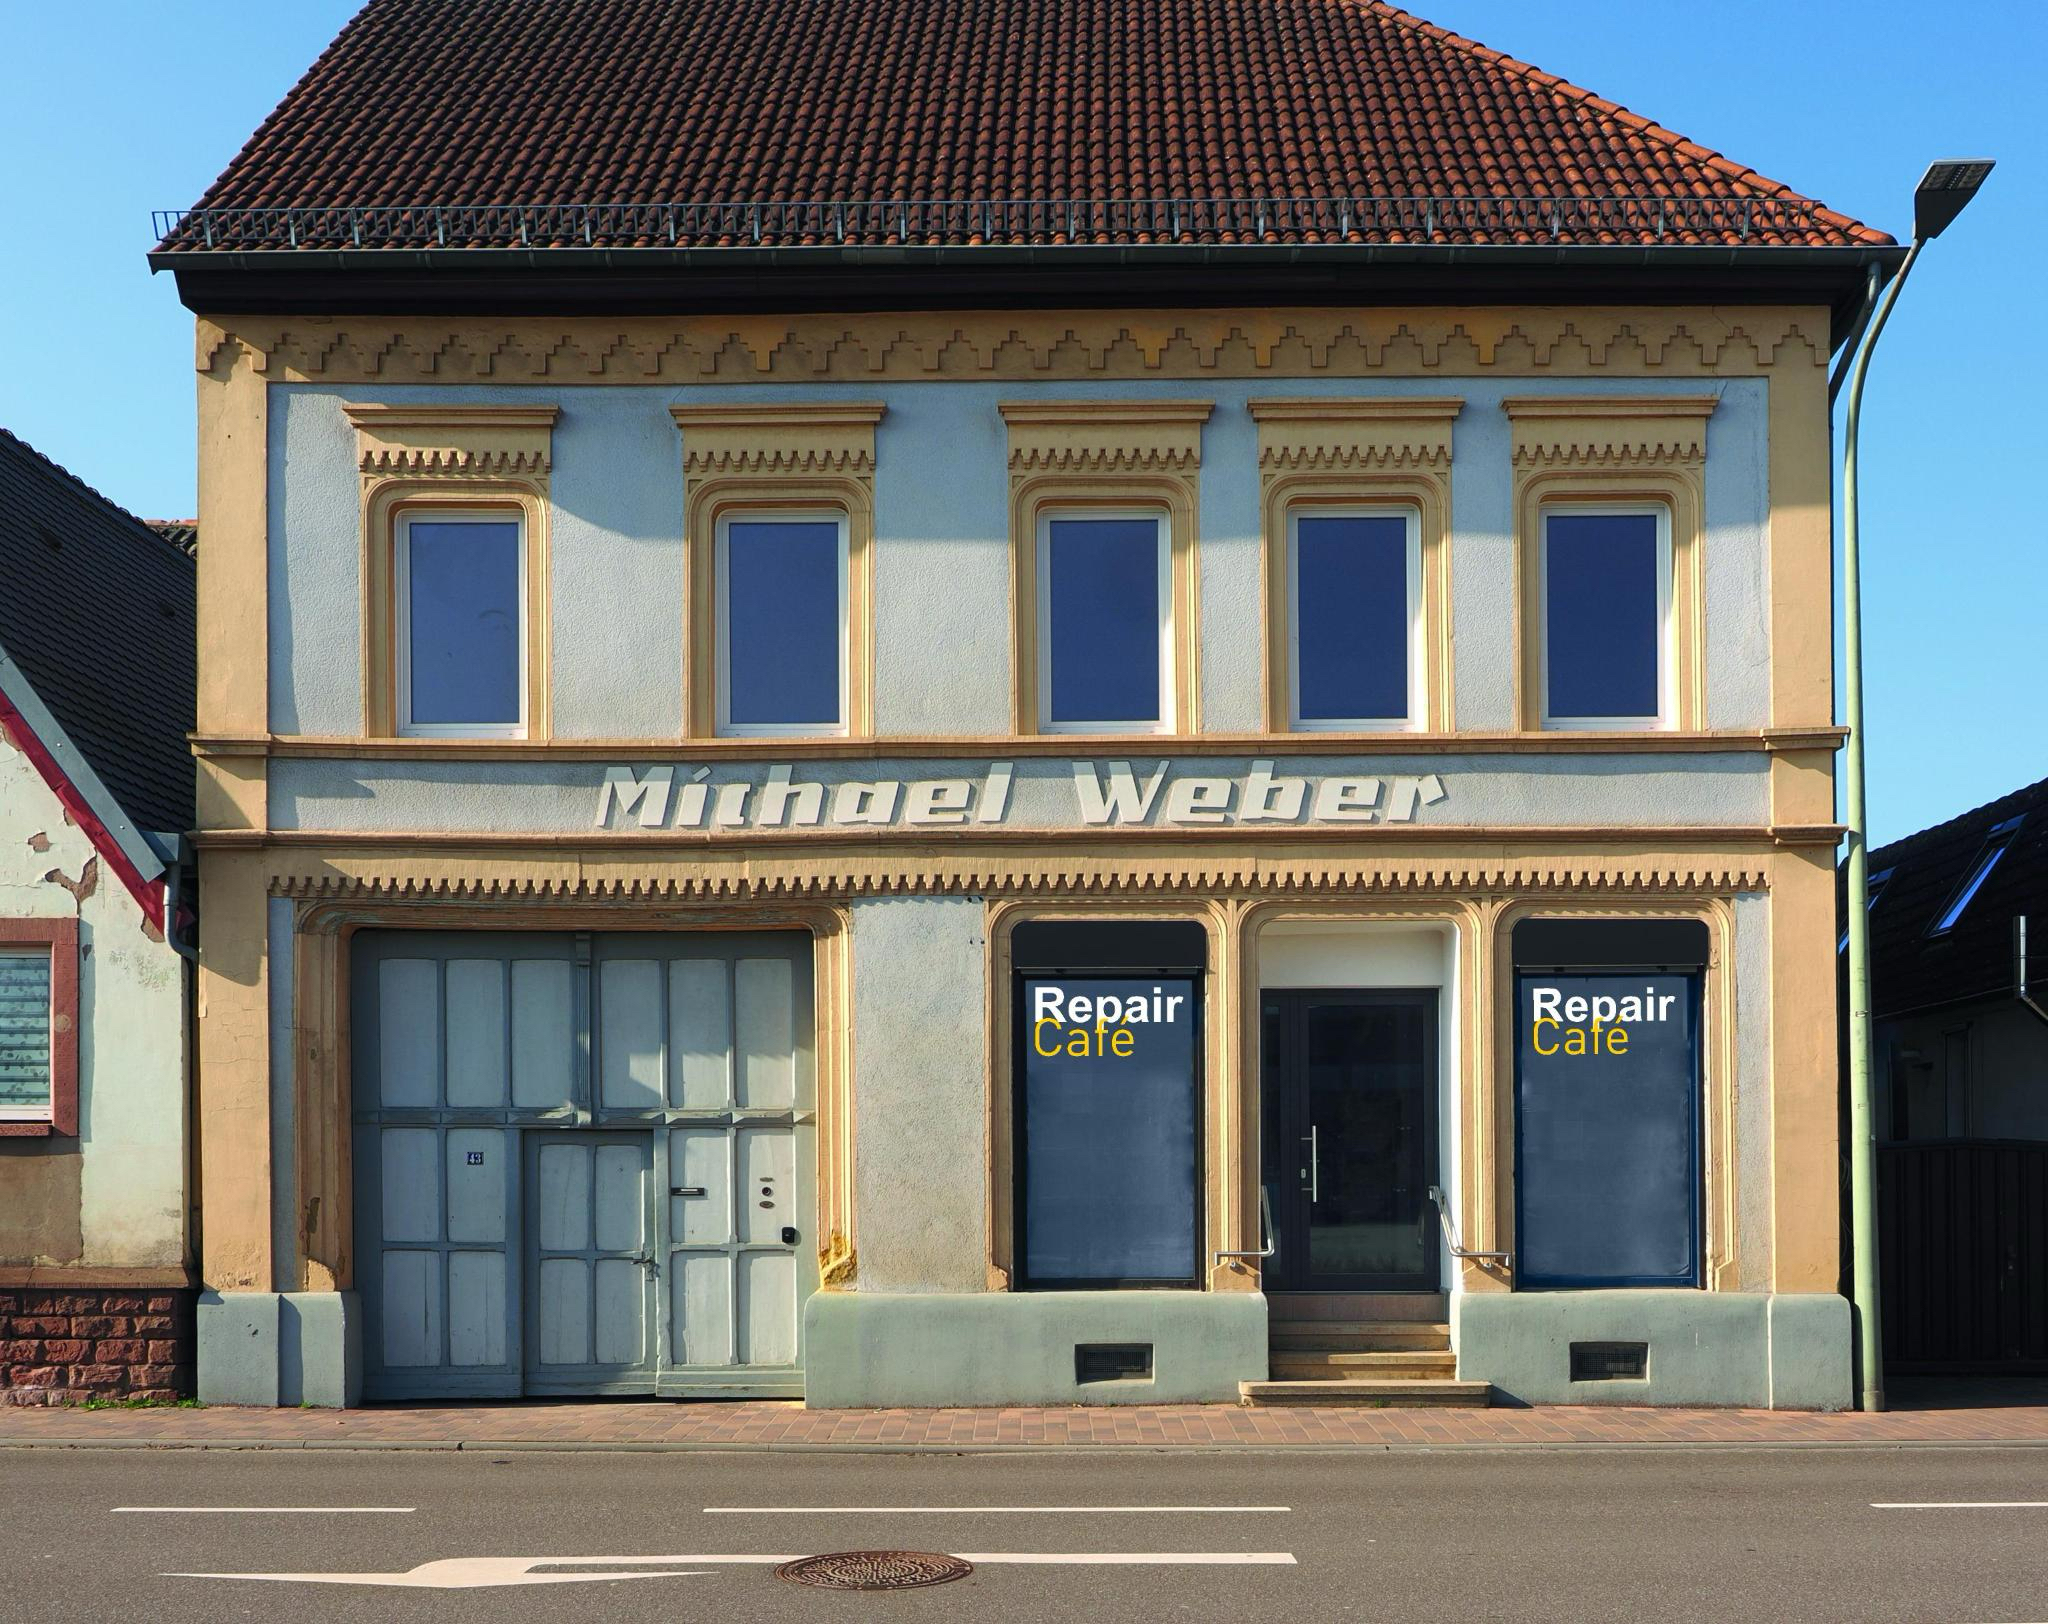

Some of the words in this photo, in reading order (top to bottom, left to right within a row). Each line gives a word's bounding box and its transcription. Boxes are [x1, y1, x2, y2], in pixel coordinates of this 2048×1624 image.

[596, 762, 1014, 826] Michael
[1071, 759, 1446, 824] Weber
[1034, 986, 1184, 1030] Repair
[1532, 986, 1676, 1030] Repair
[1034, 1015, 1135, 1057] Café
[1532, 1015, 1629, 1055] Café
